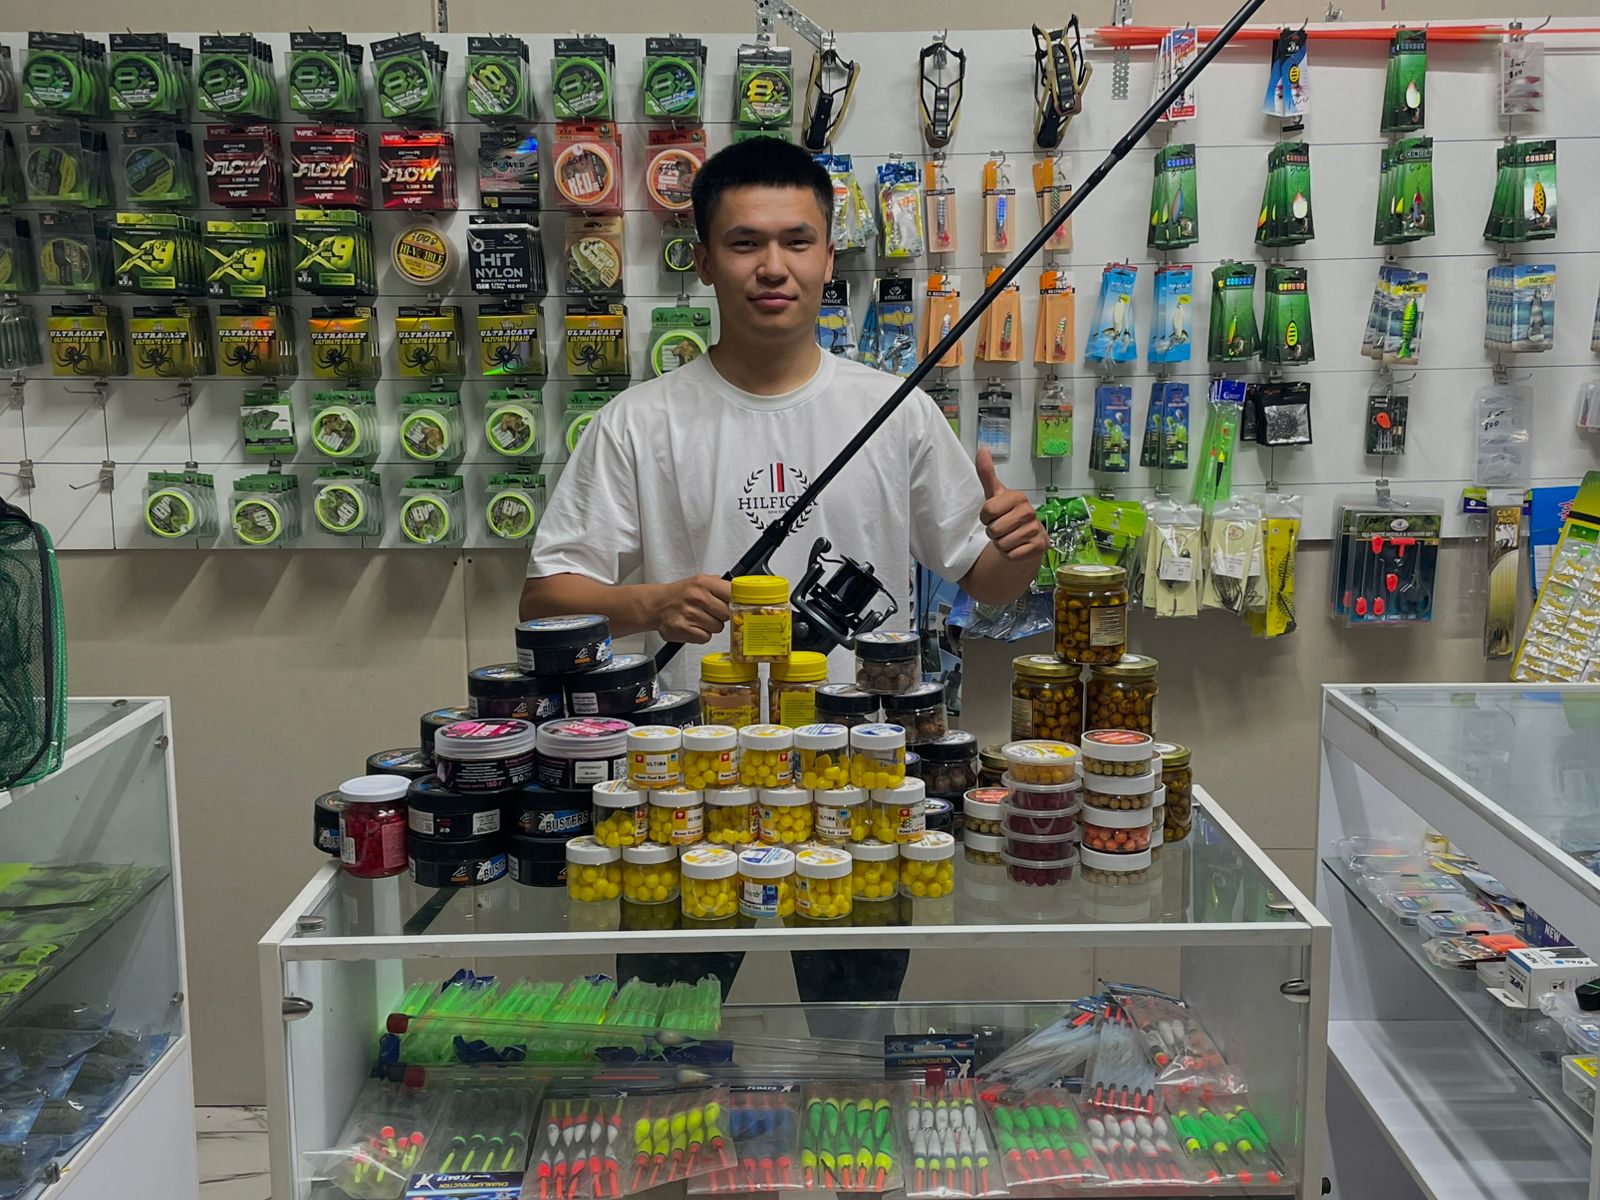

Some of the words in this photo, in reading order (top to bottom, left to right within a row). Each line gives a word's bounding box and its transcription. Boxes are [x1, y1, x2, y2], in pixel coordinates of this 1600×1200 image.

[1167, 158, 1194, 167] CONDOR
[1286, 154, 1308, 162] CONDOR
[1525, 154, 1554, 162] CONDOR
[207, 158, 266, 176] FLOW
[293, 161, 353, 178] FLOW
[381, 164, 441, 183] FLOW
[399, 244, 444, 265] HI-VIBLE
[475, 268, 523, 278] NYLON
[1279, 283, 1305, 291] CONDOR
[738, 495, 818, 510] HILFIG
[545, 811, 589, 833] BUSTERS
[1544, 924, 1561, 943] NEW
